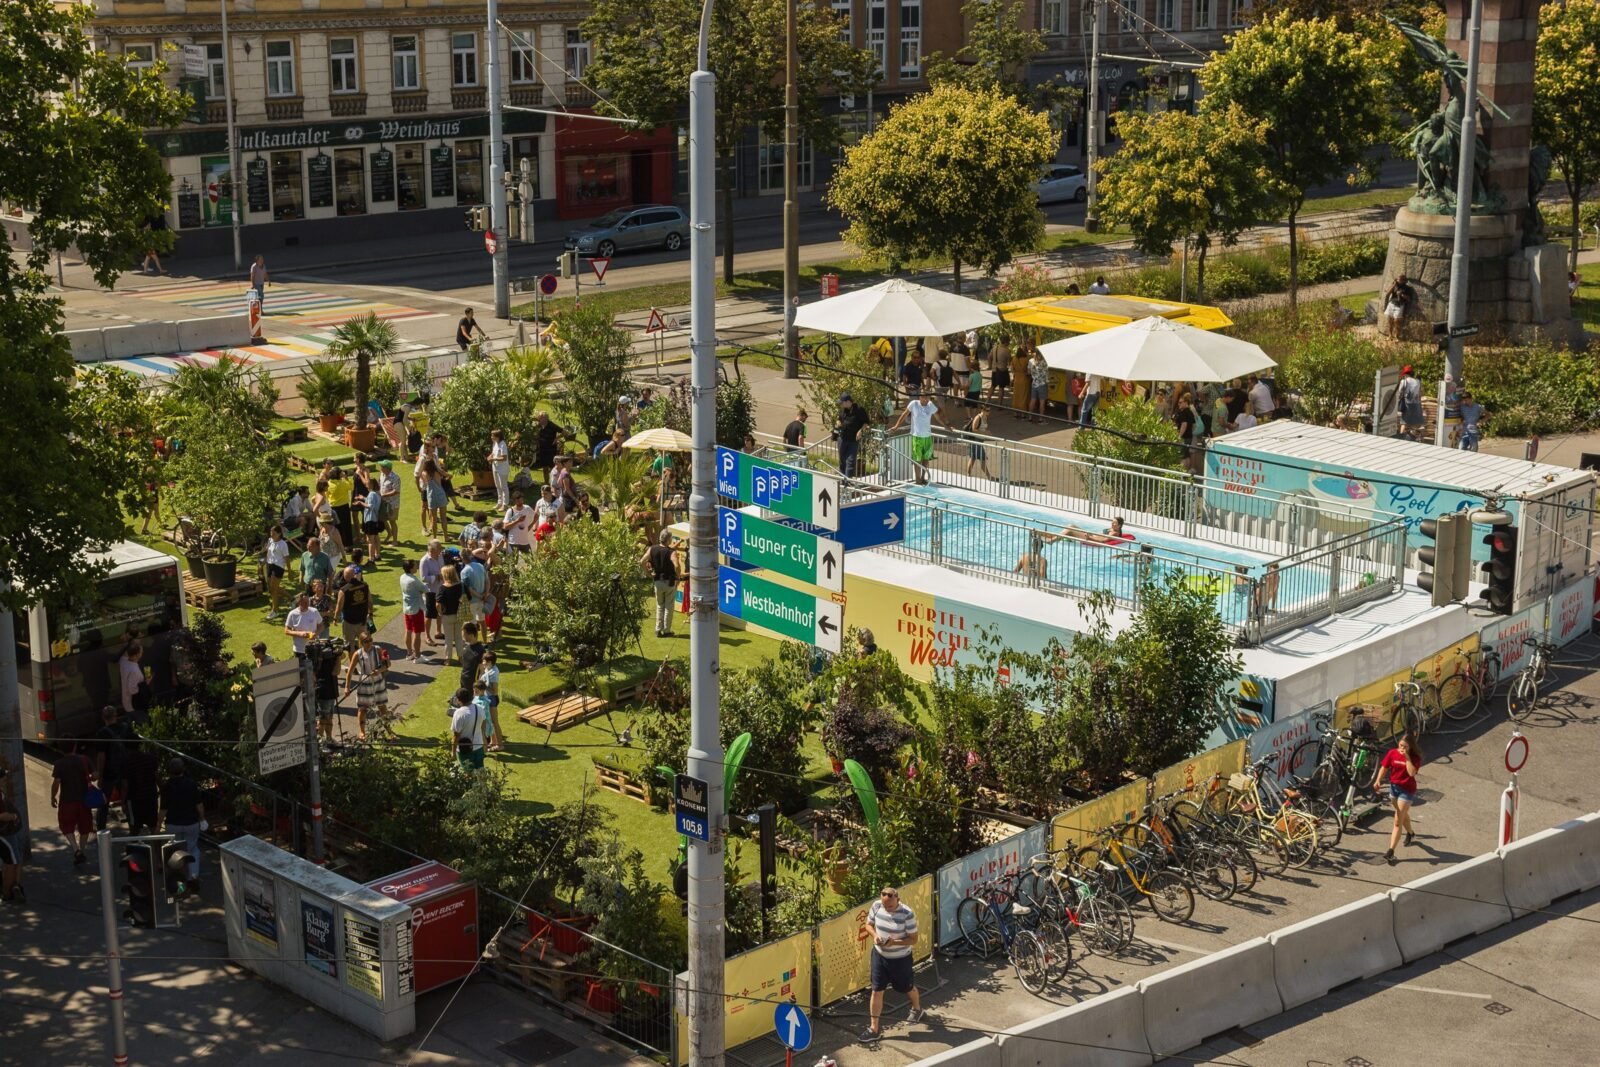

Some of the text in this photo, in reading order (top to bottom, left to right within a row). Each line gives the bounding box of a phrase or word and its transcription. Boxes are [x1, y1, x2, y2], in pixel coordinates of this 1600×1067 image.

[1079, 66, 1123, 81] PALLON
[379, 120, 461, 139] Weinhaus
[719, 479, 737, 497] Wien
[1389, 483, 1440, 515] Pool
[744, 528, 786, 557] Lugner
[790, 543, 815, 569] City
[743, 588, 814, 628] Westbahnhof
[902, 601, 967, 632] GÜRTEL
[897, 618, 972, 650] FRISCHE
[910, 637, 959, 668] West
[676, 798, 707, 813] KRONEHIT
[439, 899, 466, 915] ELECTRIC
[305, 911, 330, 935] Klang
[306, 922, 326, 944] Burg
[396, 921, 410, 995] RAF CAMORA
